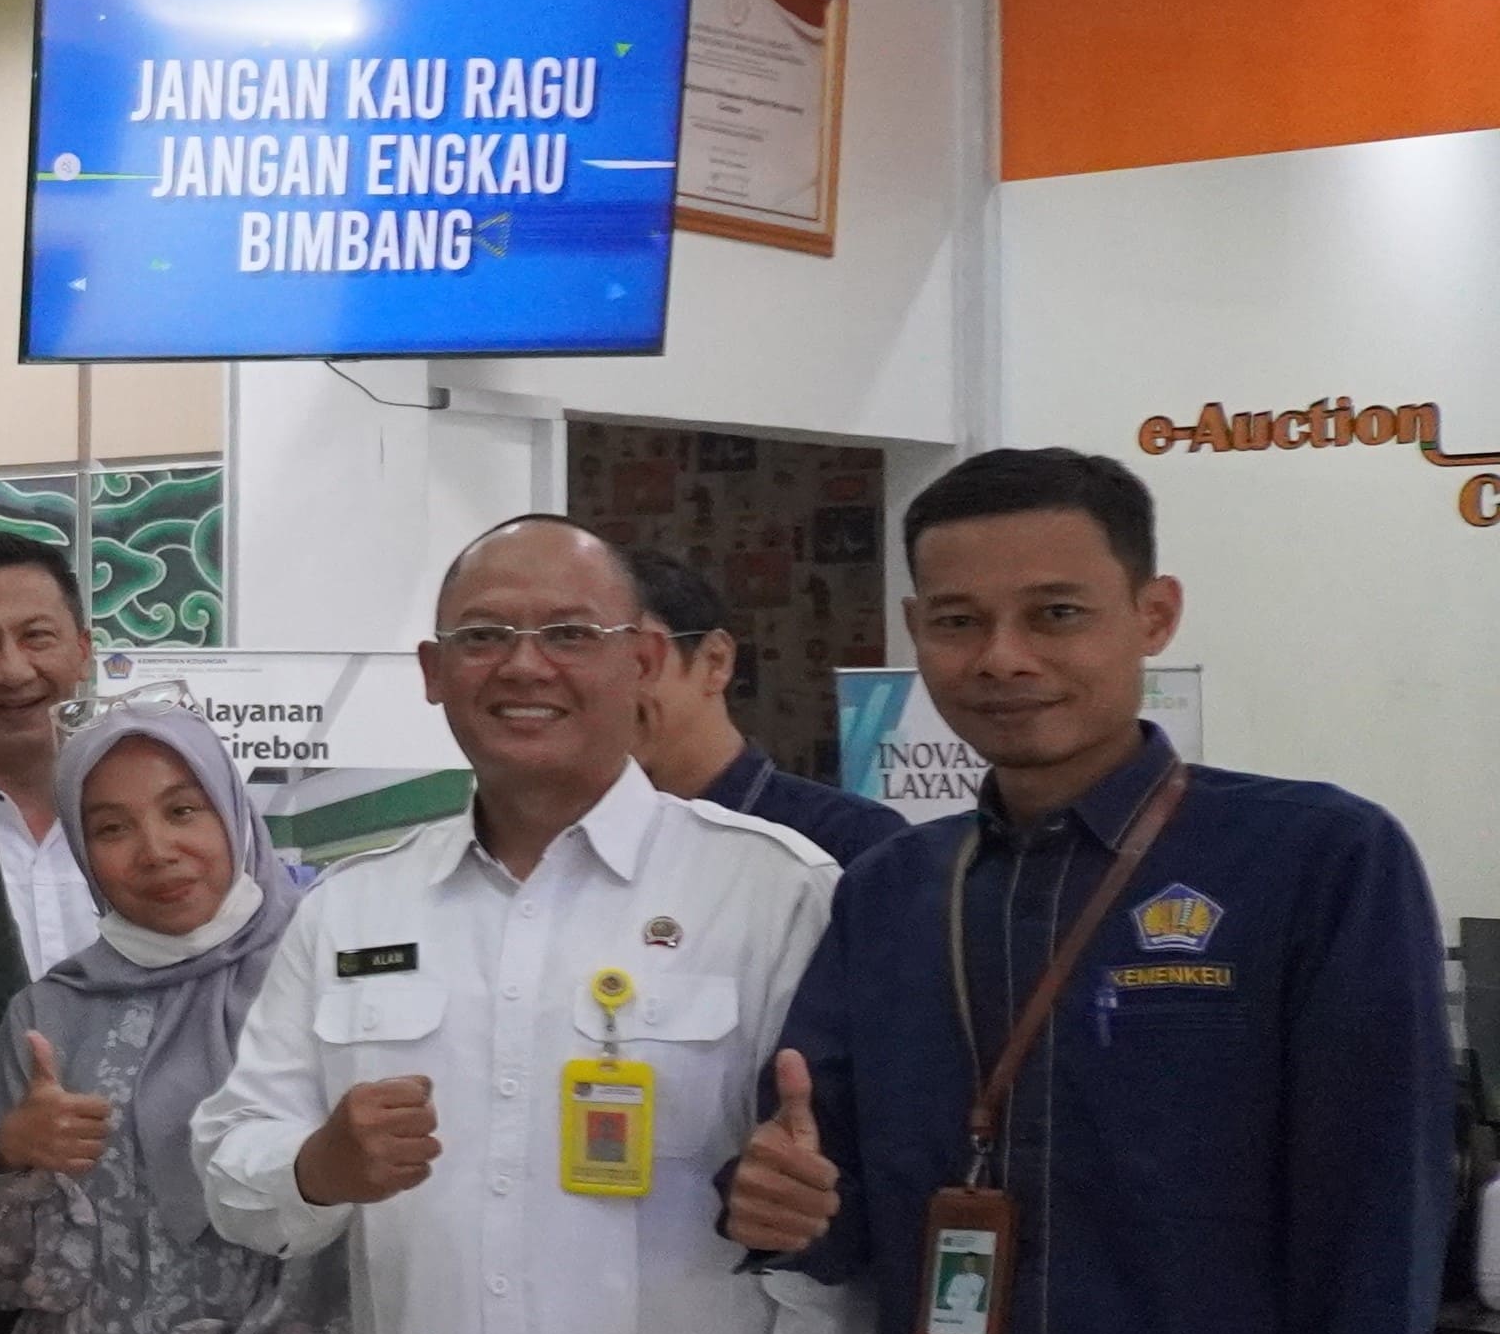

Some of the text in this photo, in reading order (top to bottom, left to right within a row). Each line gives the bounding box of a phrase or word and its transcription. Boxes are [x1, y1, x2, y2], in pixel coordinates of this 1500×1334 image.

[130, 57, 596, 121] JANGAN KAU RAGU
[152, 133, 566, 197] JANGAN ENGKAU
[240, 209, 473, 272] BIMBANG
[1138, 396, 1440, 455] e-Auction
[220, 733, 329, 760] irebon
[881, 773, 980, 799] LAYAN
